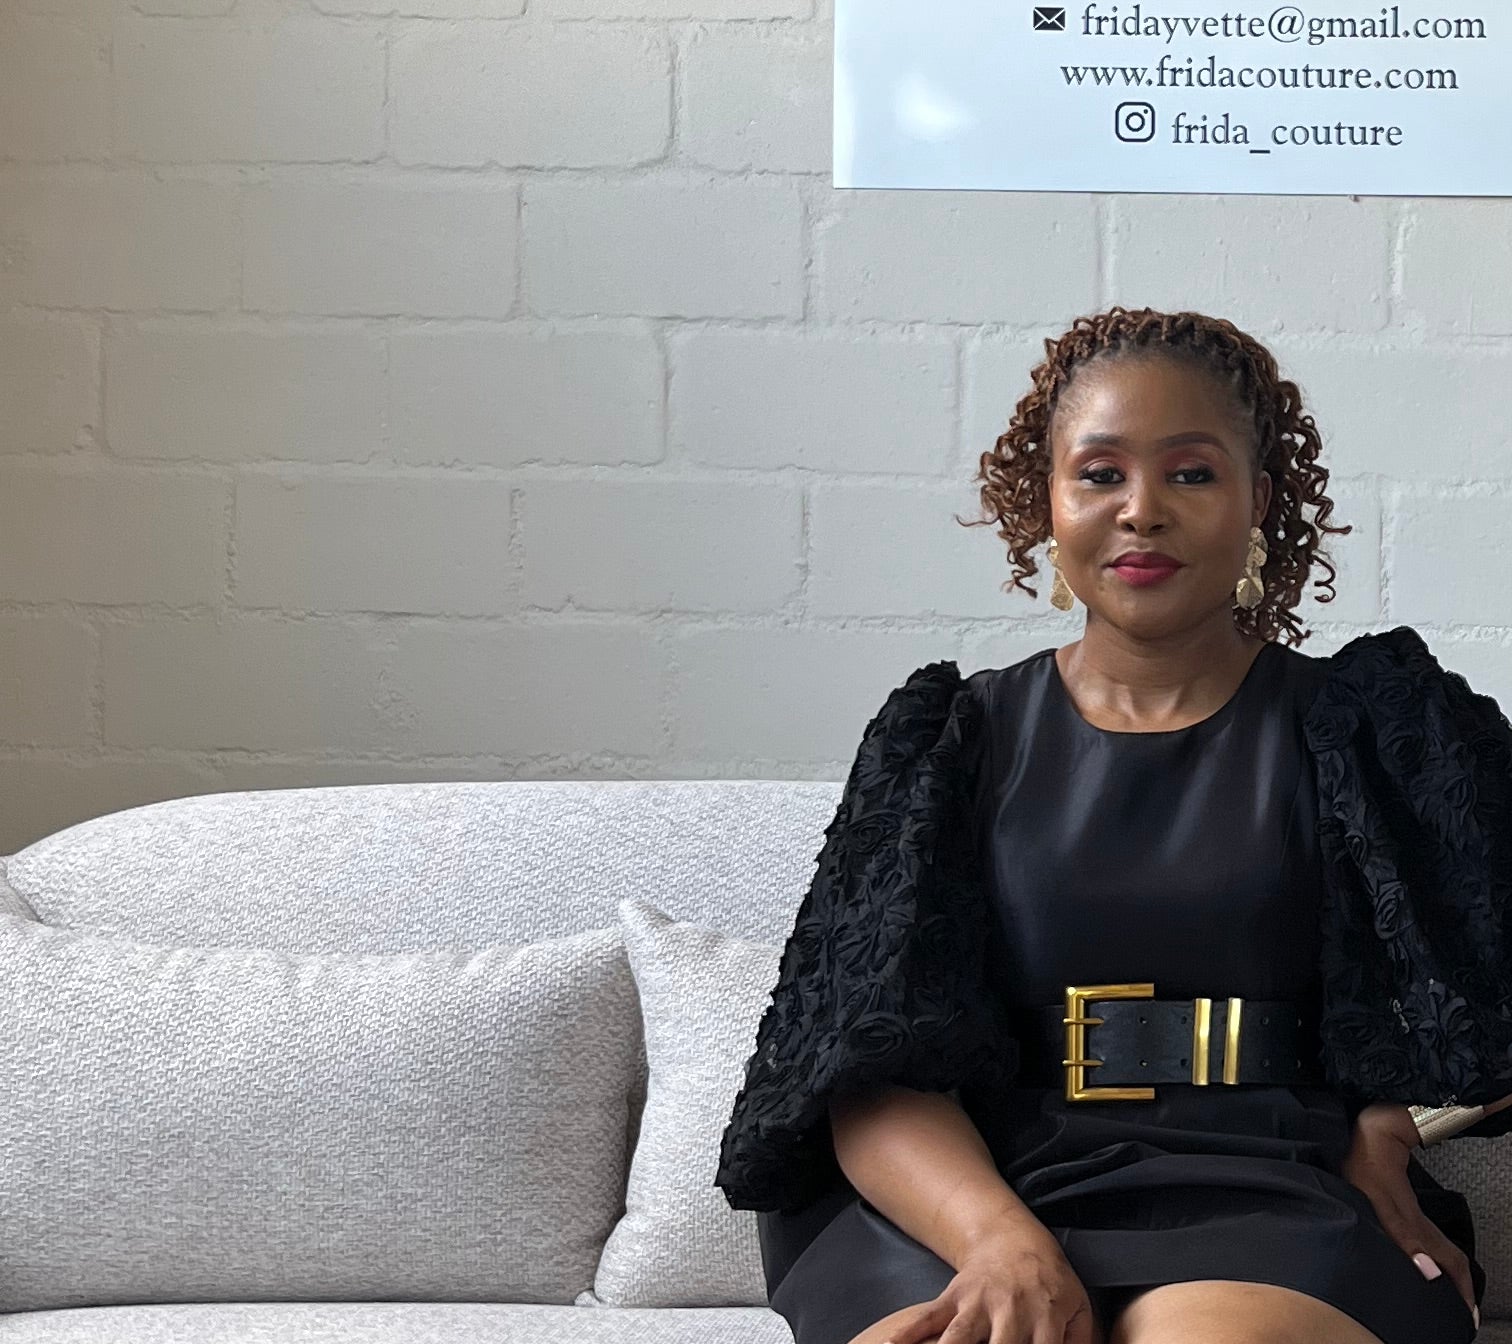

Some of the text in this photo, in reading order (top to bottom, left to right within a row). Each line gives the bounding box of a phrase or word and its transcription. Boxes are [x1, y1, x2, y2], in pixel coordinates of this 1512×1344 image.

[1081, 3, 1487, 44] fridayvette@gmail.com
[1060, 56, 1459, 92] www.fridacouture.com
[1171, 112, 1404, 154] frida_couture
